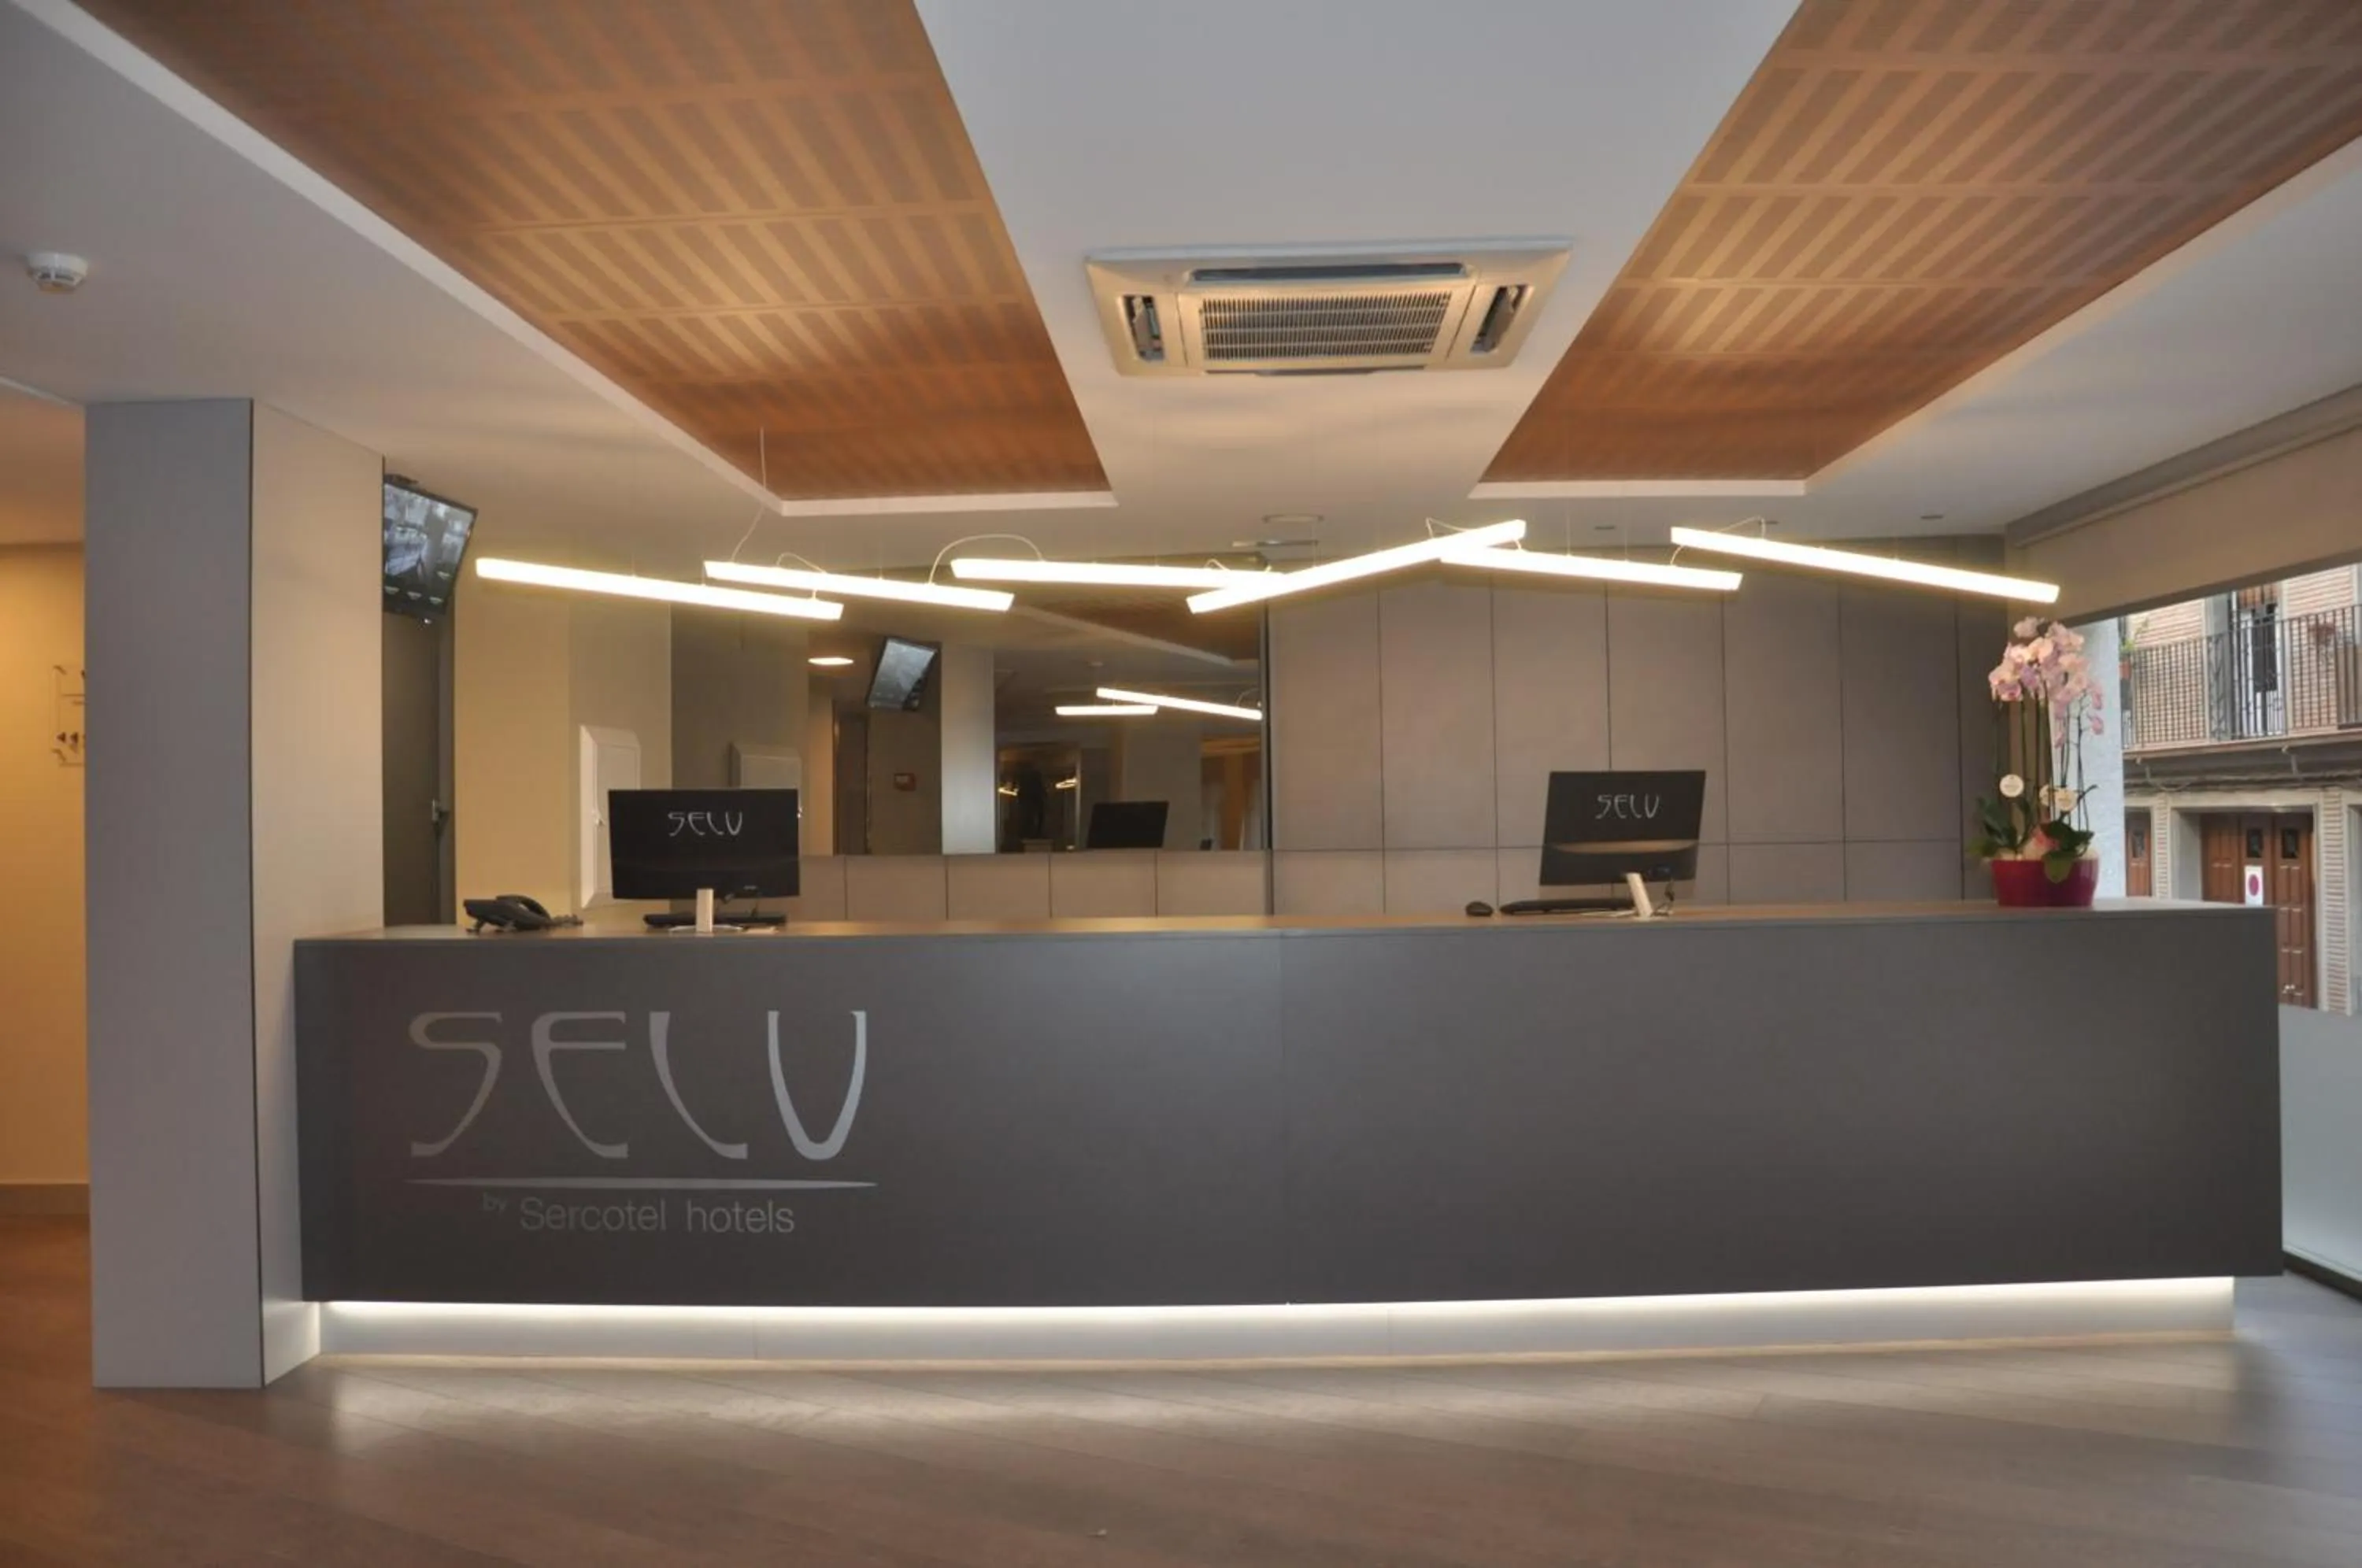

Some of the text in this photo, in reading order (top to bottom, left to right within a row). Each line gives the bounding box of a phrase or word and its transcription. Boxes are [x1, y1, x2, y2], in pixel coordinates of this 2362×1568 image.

[483, 1193, 795, 1233] by Sercotel hotels
